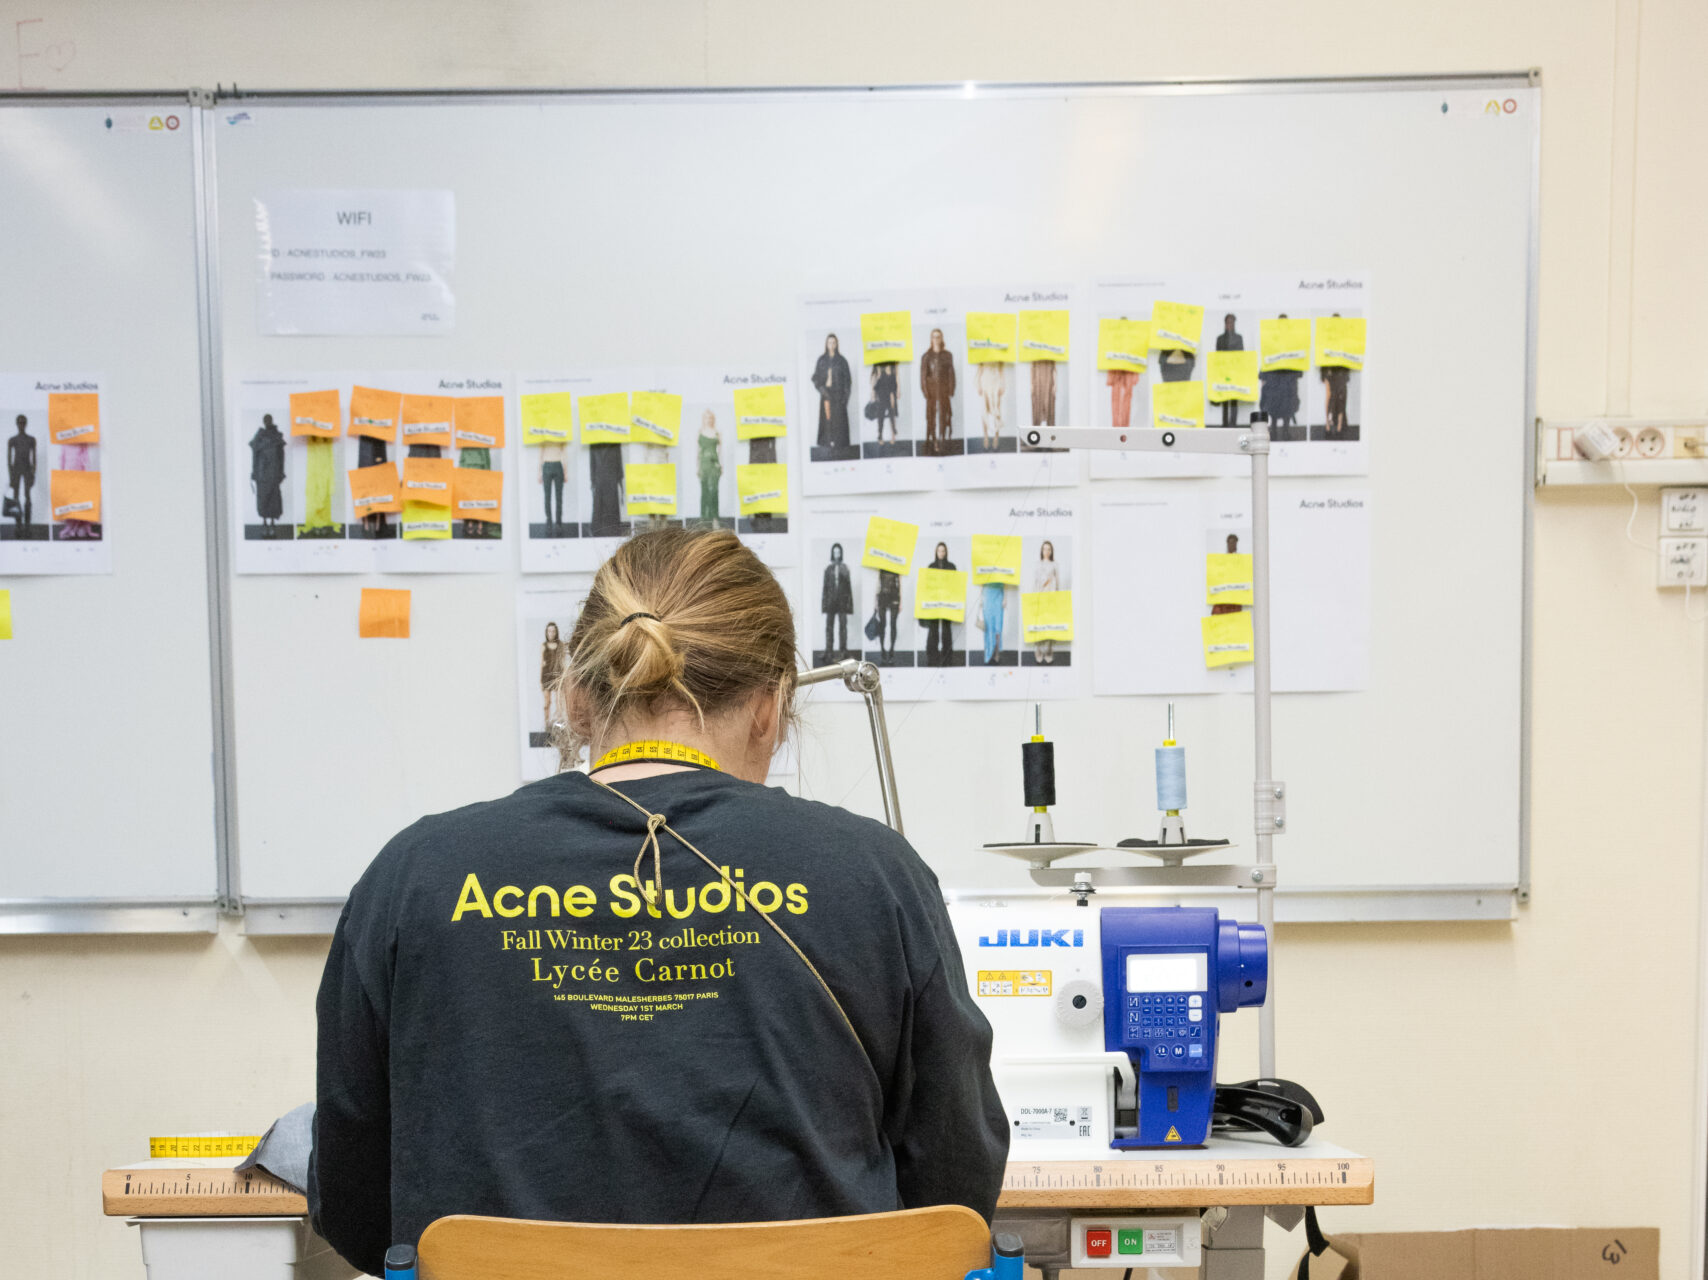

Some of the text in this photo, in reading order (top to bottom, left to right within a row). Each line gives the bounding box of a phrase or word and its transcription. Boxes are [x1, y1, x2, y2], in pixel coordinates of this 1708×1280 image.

[336, 211, 372, 225] WIFI
[1298, 279, 1363, 290] Acne Studios
[1004, 292, 1068, 303] Acne Studios
[438, 379, 502, 389] Acne Studios
[723, 374, 786, 384] Acne Studios
[1299, 498, 1364, 508] Acne Studios
[1008, 507, 1073, 517] Acne Studios
[451, 866, 809, 922] Acne Studios
[501, 925, 761, 951] Fall Winter 23 collection
[978, 929, 1084, 947] JUKI
[531, 956, 736, 988] Lycée Carnot
[567, 994, 614, 1002] BOULEVARD
[615, 994, 673, 1003] MALESHERBES
[590, 1003, 638, 1012] WEDNESDAY
[655, 1003, 683, 1011] MARCH
[1032, 1166, 1041, 1174] 75
[1093, 1165, 1103, 1173] 80
[1154, 1165, 1164, 1173] 85
[1216, 1164, 1225, 1172] 90
[1337, 1162, 1350, 1170] 100
[1091, 1238, 1137, 1247] OFF ON
